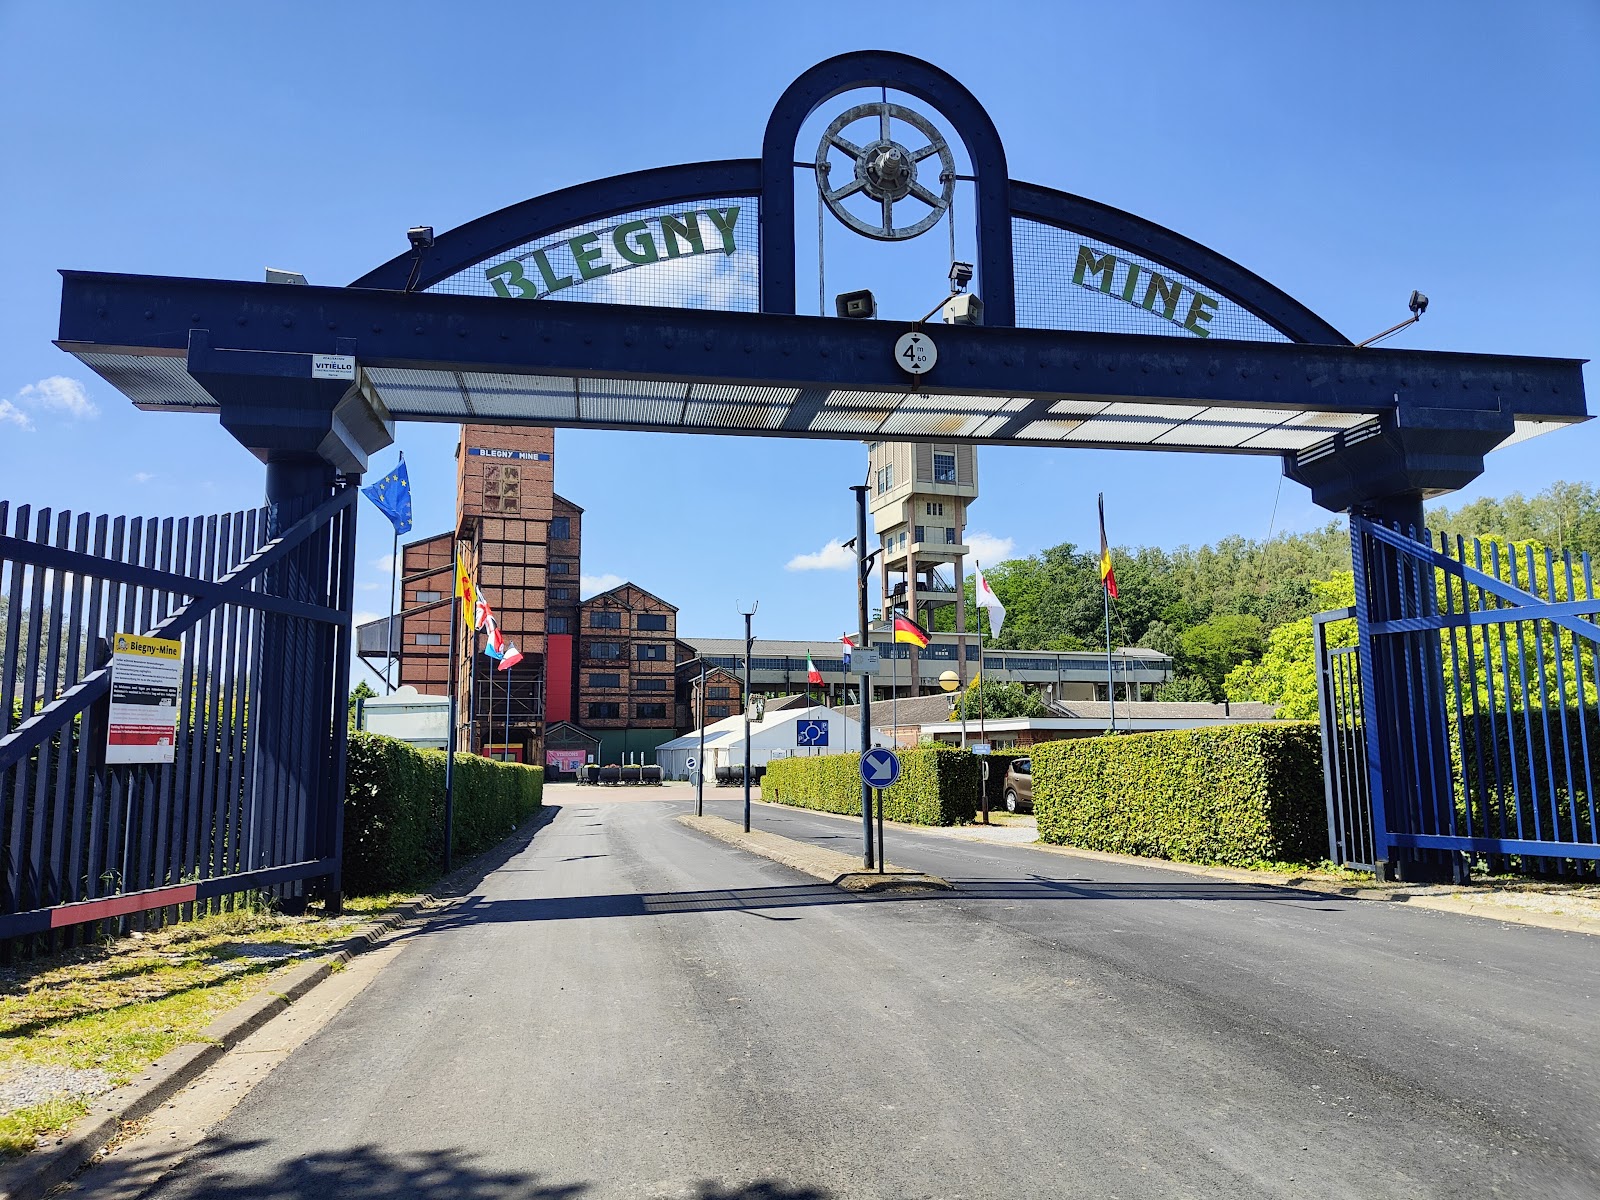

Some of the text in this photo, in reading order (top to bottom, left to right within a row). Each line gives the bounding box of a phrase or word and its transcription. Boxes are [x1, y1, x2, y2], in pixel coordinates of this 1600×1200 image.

[485, 206, 741, 299] BLEGNY
[1072, 245, 1219, 338] MINE
[902, 344, 916, 362] 4
[480, 449, 539, 461] BLEGNY MINE
[130, 641, 177, 656] Blegny-Mine
